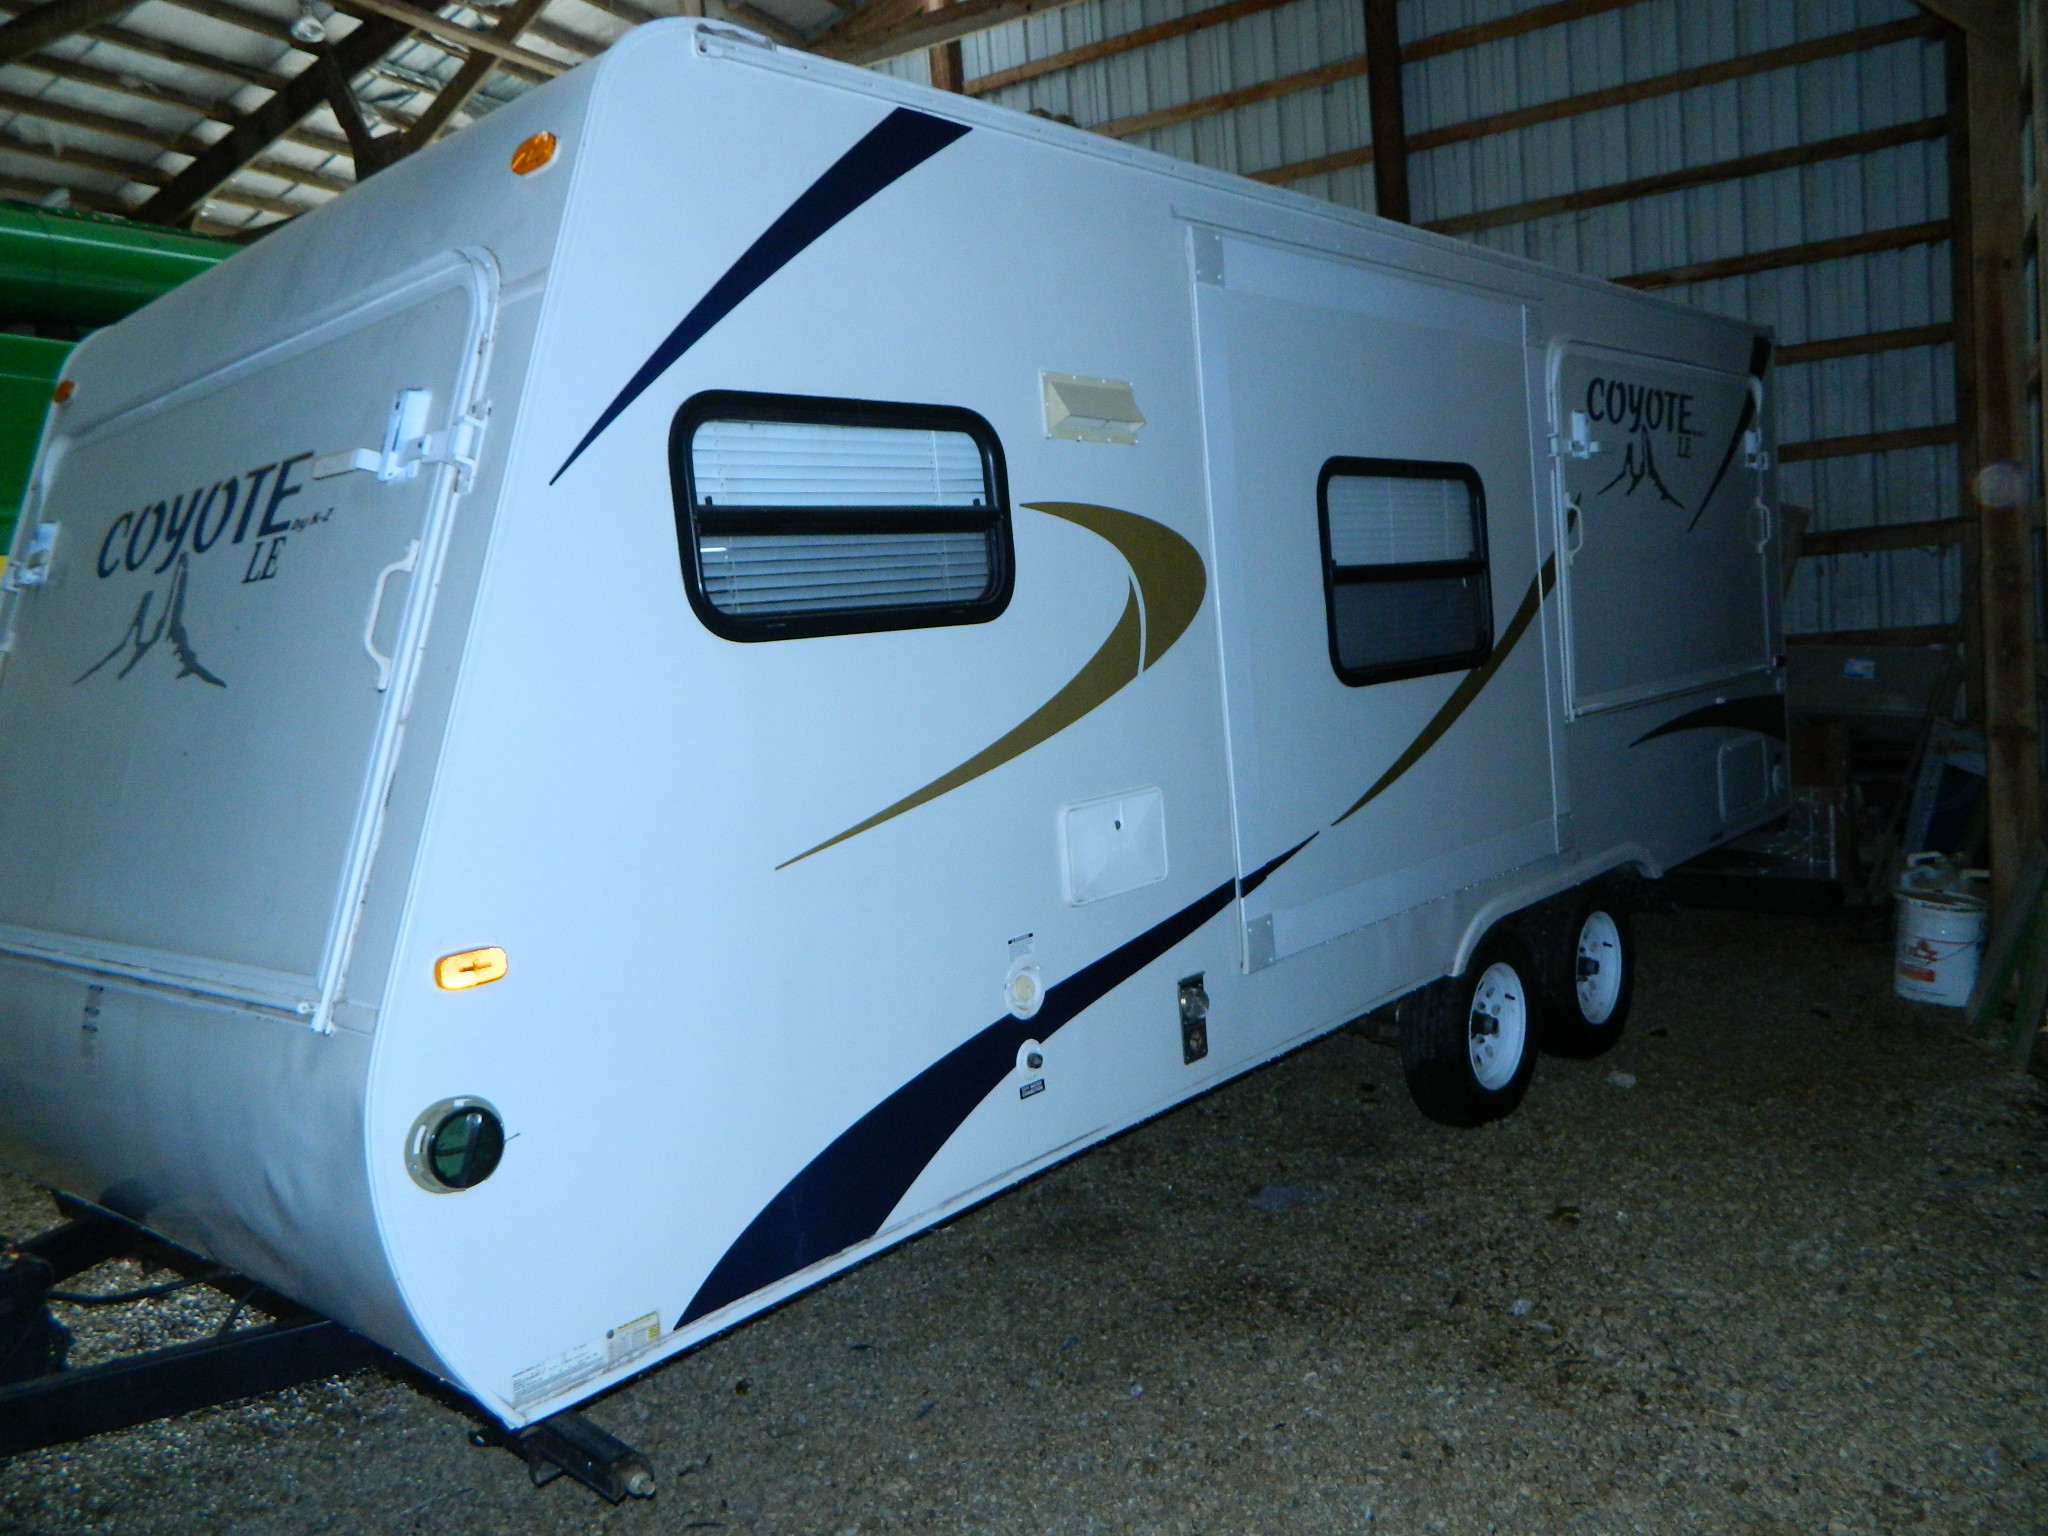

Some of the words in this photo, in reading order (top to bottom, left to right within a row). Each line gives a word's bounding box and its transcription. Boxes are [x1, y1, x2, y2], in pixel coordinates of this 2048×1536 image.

[1587, 377, 1694, 434] COYOTE
[97, 451, 314, 579] COYOTE
[242, 536, 287, 584] LE
